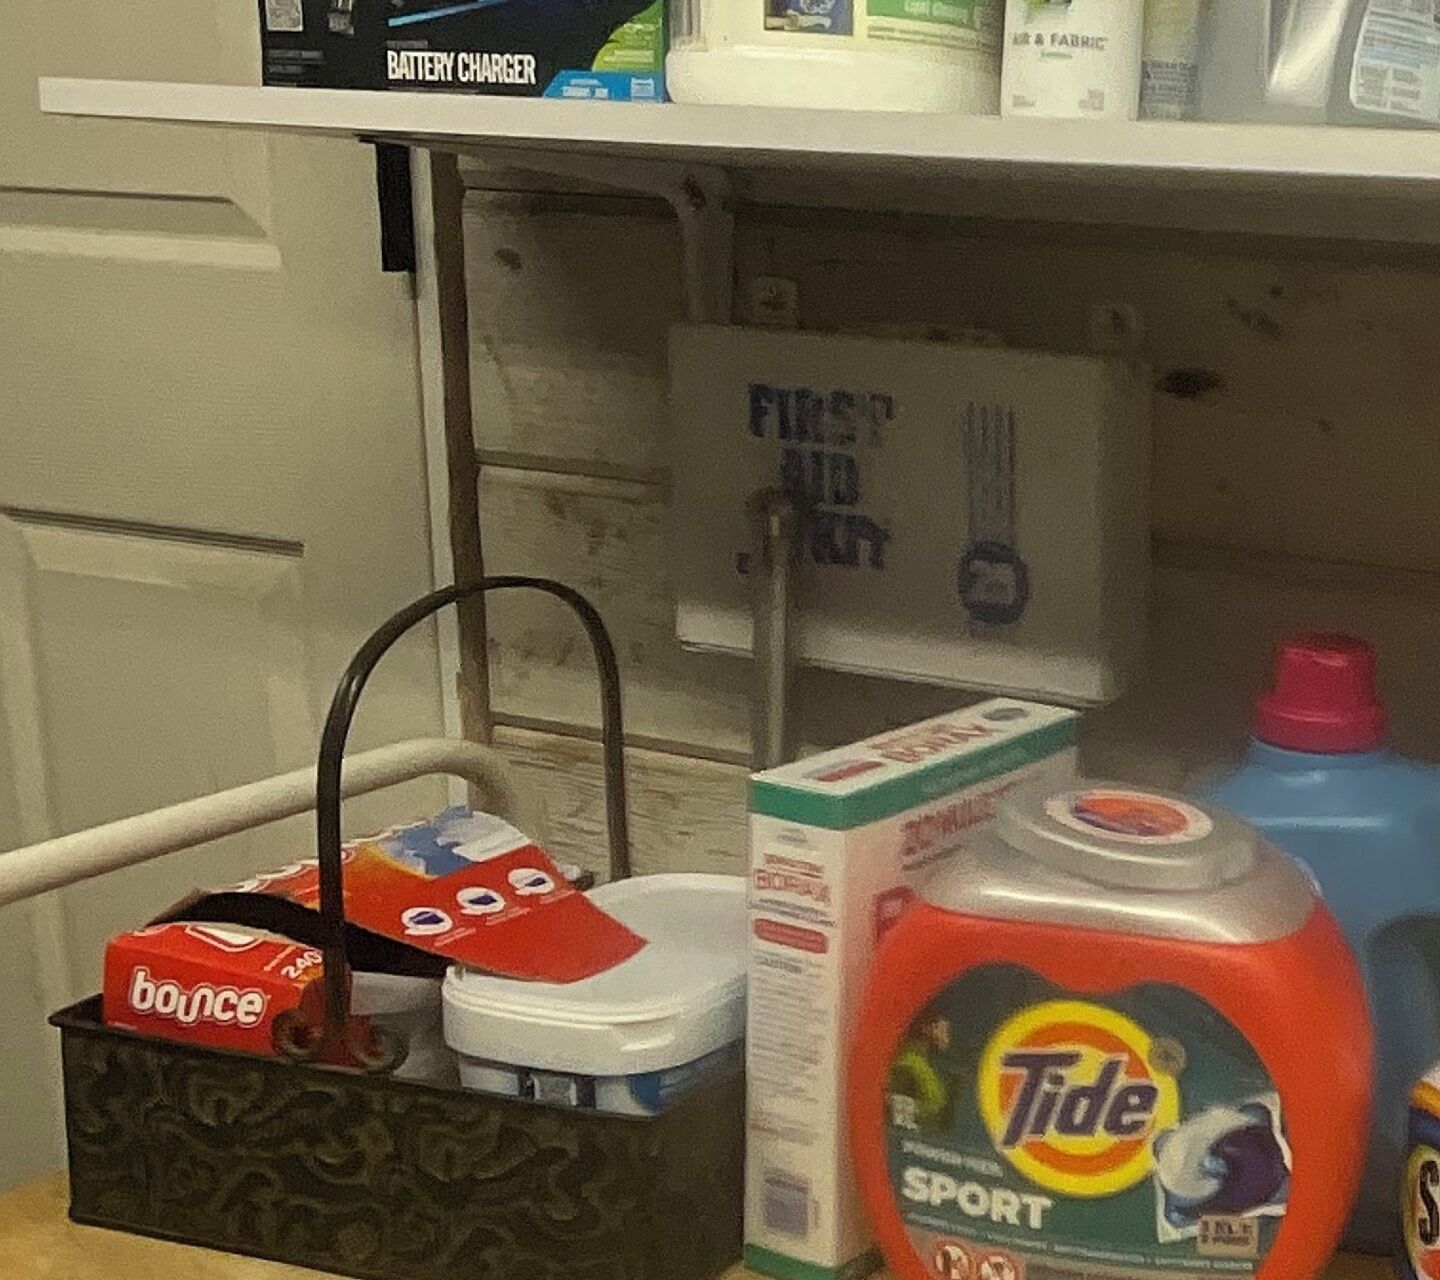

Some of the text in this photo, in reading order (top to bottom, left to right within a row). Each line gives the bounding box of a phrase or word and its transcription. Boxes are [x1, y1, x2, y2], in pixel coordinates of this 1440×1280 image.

[387, 50, 537, 85] BATTERY CHARGER
[1034, 32, 1045, 47] &
[1049, 33, 1105, 51] FABRIC
[748, 383, 894, 447] FIRST
[132, 969, 265, 1024] bounce
[1003, 1052, 1159, 1150] Tide
[902, 1166, 1055, 1230] SPORT
